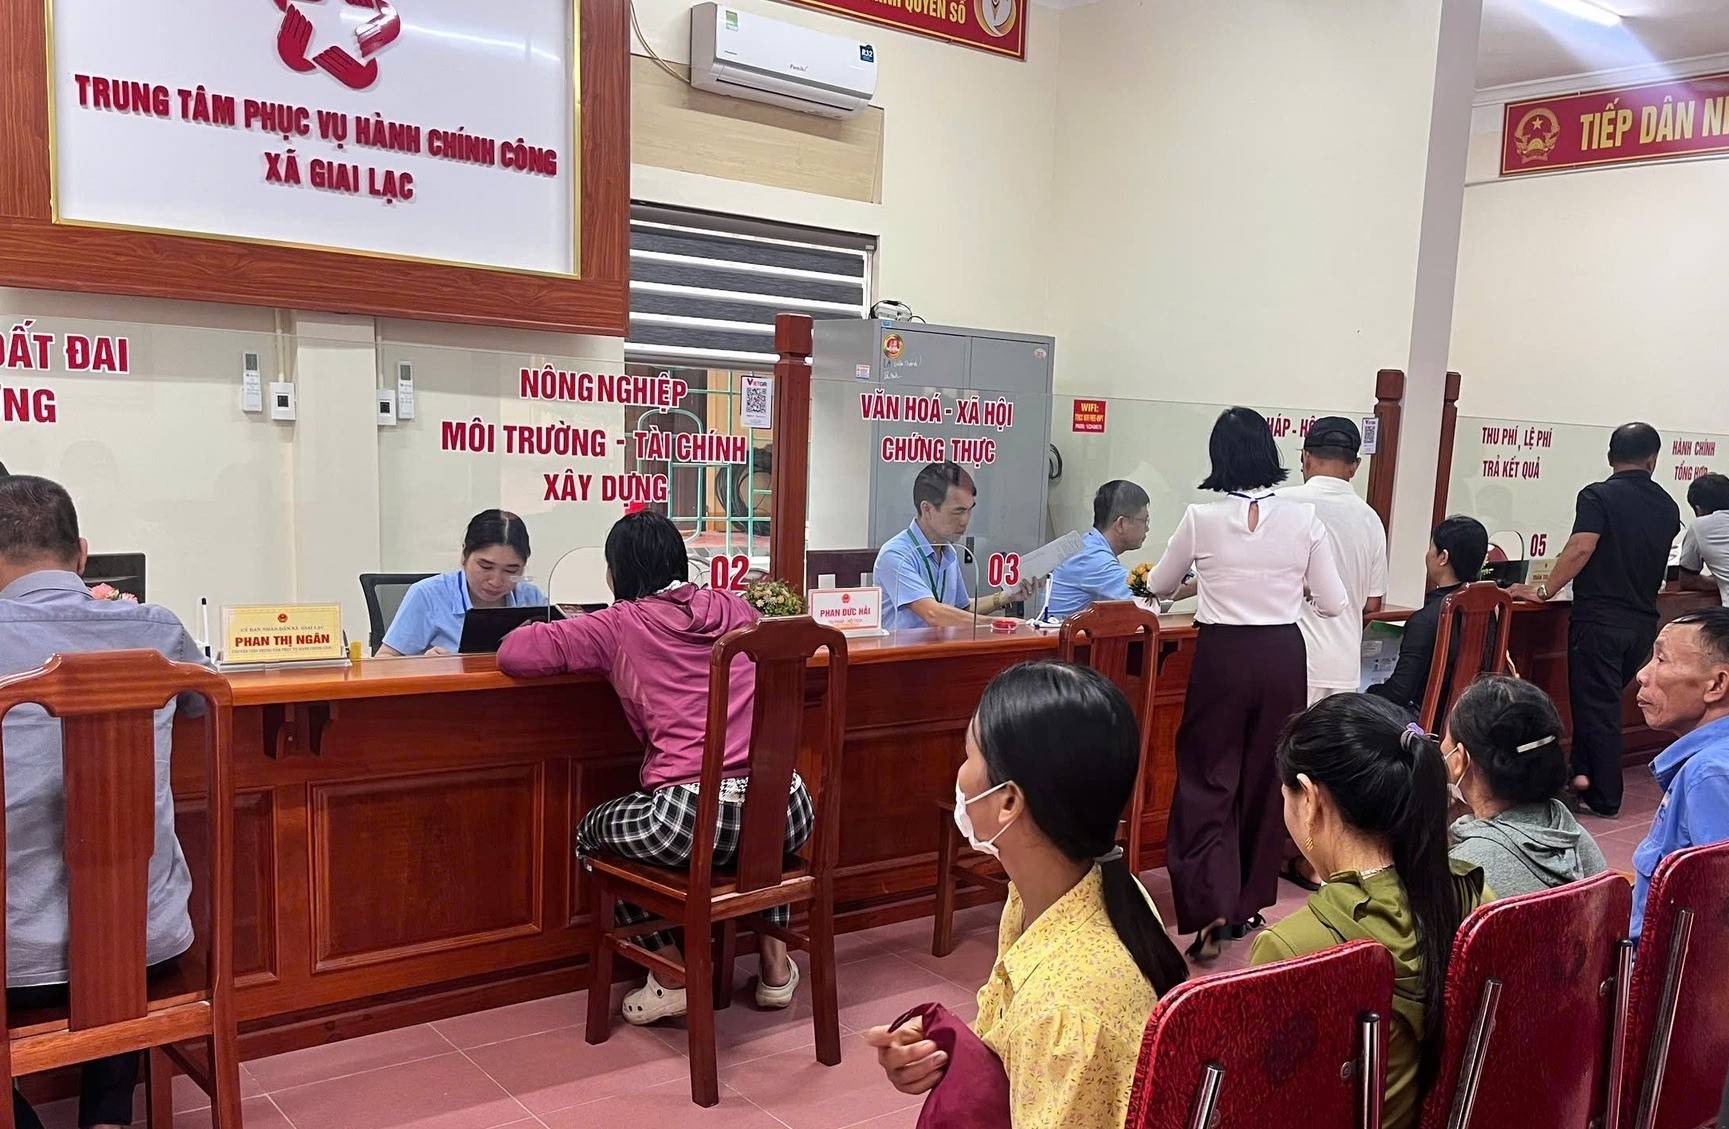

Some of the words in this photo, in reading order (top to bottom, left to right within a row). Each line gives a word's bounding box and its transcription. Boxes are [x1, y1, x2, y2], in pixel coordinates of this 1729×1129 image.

[949, 0, 966, 24] SỐ
[861, 48, 873, 57] R32
[75, 74, 169, 117] TRUNG
[177, 85, 236, 126] TÂM
[244, 98, 311, 141] PHỤC
[318, 109, 349, 149] VỤ
[355, 109, 421, 153] HÀNH
[427, 126, 495, 166] CHÍNH
[499, 136, 559, 177] CÔNG
[1580, 98, 1633, 151] TIẾP
[1639, 95, 1695, 145] DÂN
[264, 148, 302, 185] XÃ
[309, 158, 360, 193] GIAI
[367, 165, 415, 204] LẠC
[64, 333, 129, 374] ĐAI
[521, 365, 593, 400] NÔNG
[598, 373, 688, 413] NGHIỆP
[860, 389, 900, 421] VĂN
[904, 389, 941, 424] HOÁ
[956, 394, 980, 426] XÃ
[984, 397, 1014, 430] HỘI
[1081, 403, 1099, 412] WIFI:
[441, 418, 495, 453] MÔI
[503, 420, 606, 458] TRƯỜNG
[634, 424, 671, 462] TÀI
[676, 425, 747, 463] CHÍNH
[881, 431, 946, 464] CHỨNG
[951, 436, 996, 470] THỰC
[1482, 427, 1500, 445] THU
[1524, 427, 1536, 450] LỆ
[1537, 428, 1553, 448] PHÍ
[1672, 437, 1692, 456] HÀNH
[1694, 439, 1716, 456] CHÍNH
[1483, 455, 1500, 477] TRẢ
[1502, 455, 1520, 478] KẾT
[1522, 456, 1540, 479] QUẢ
[544, 469, 592, 502] XÂY
[601, 470, 668, 508] DỰNG
[1530, 533, 1548, 557] 05
[710, 556, 751, 592] 02
[988, 553, 1021, 587] 03
[820, 608, 841, 617] PHAN
[235, 636, 270, 647] PHAN
[273, 634, 292, 647] THỊ
[296, 633, 330, 645] NGÂN
